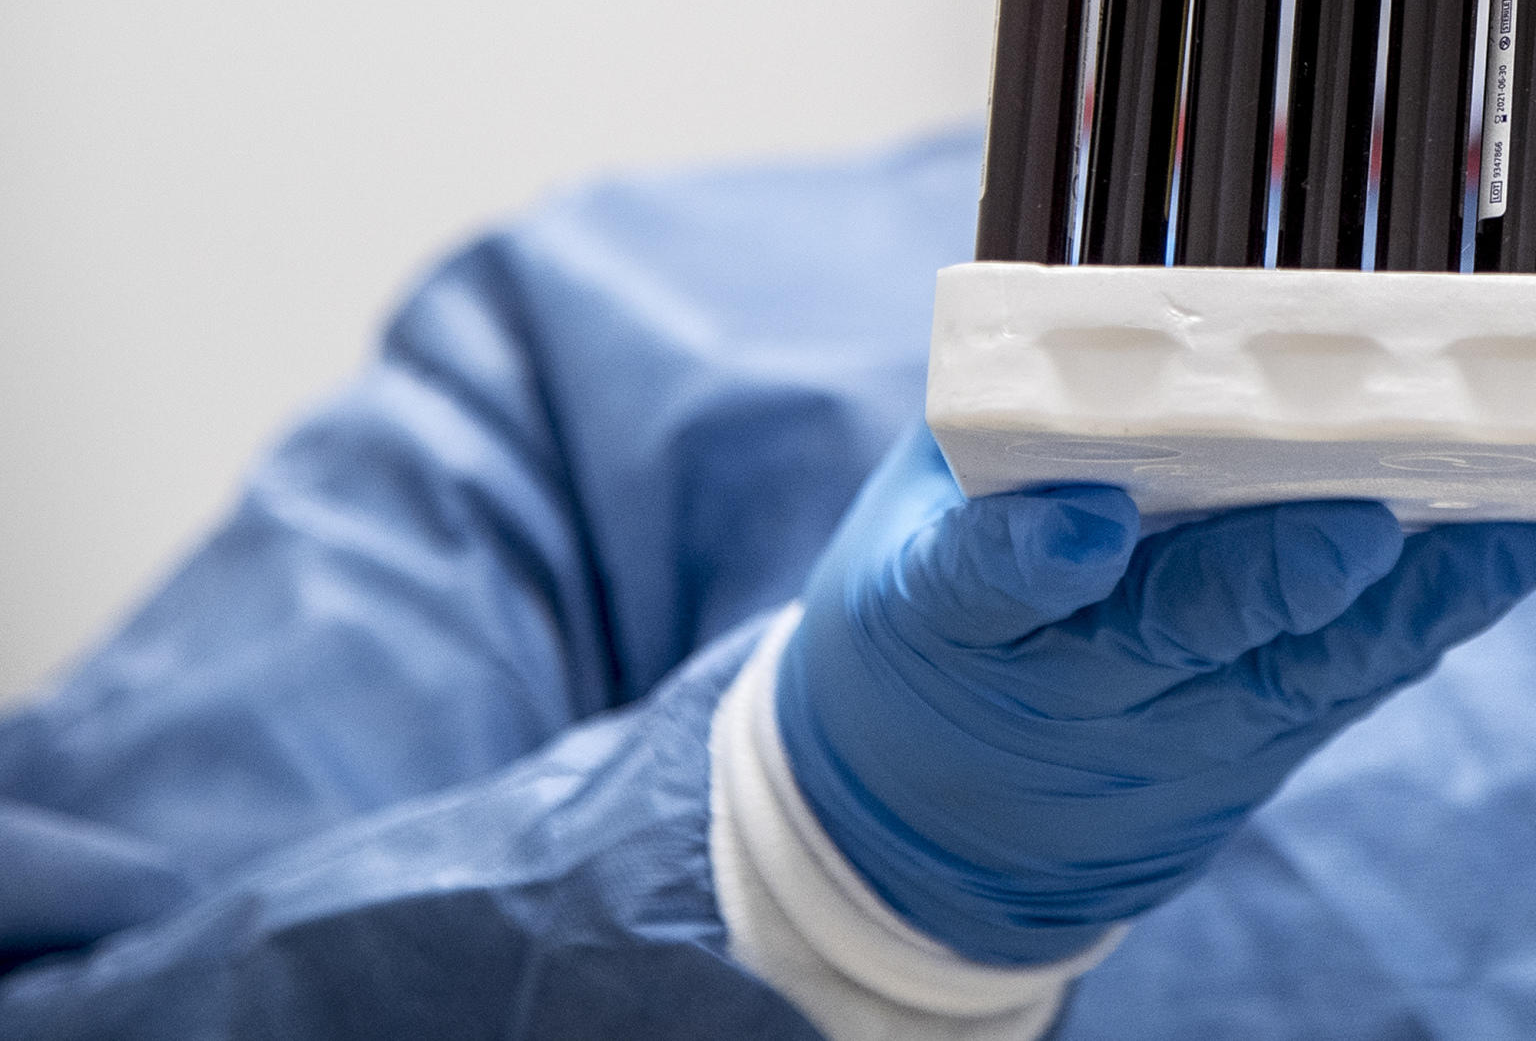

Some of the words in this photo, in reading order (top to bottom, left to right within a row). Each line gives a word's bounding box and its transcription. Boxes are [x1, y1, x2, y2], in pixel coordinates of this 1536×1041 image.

[1496, 64, 1507, 112] 2021-06-30
[1493, 141, 1503, 178] 9347866
[1491, 183, 1502, 202] LOT
